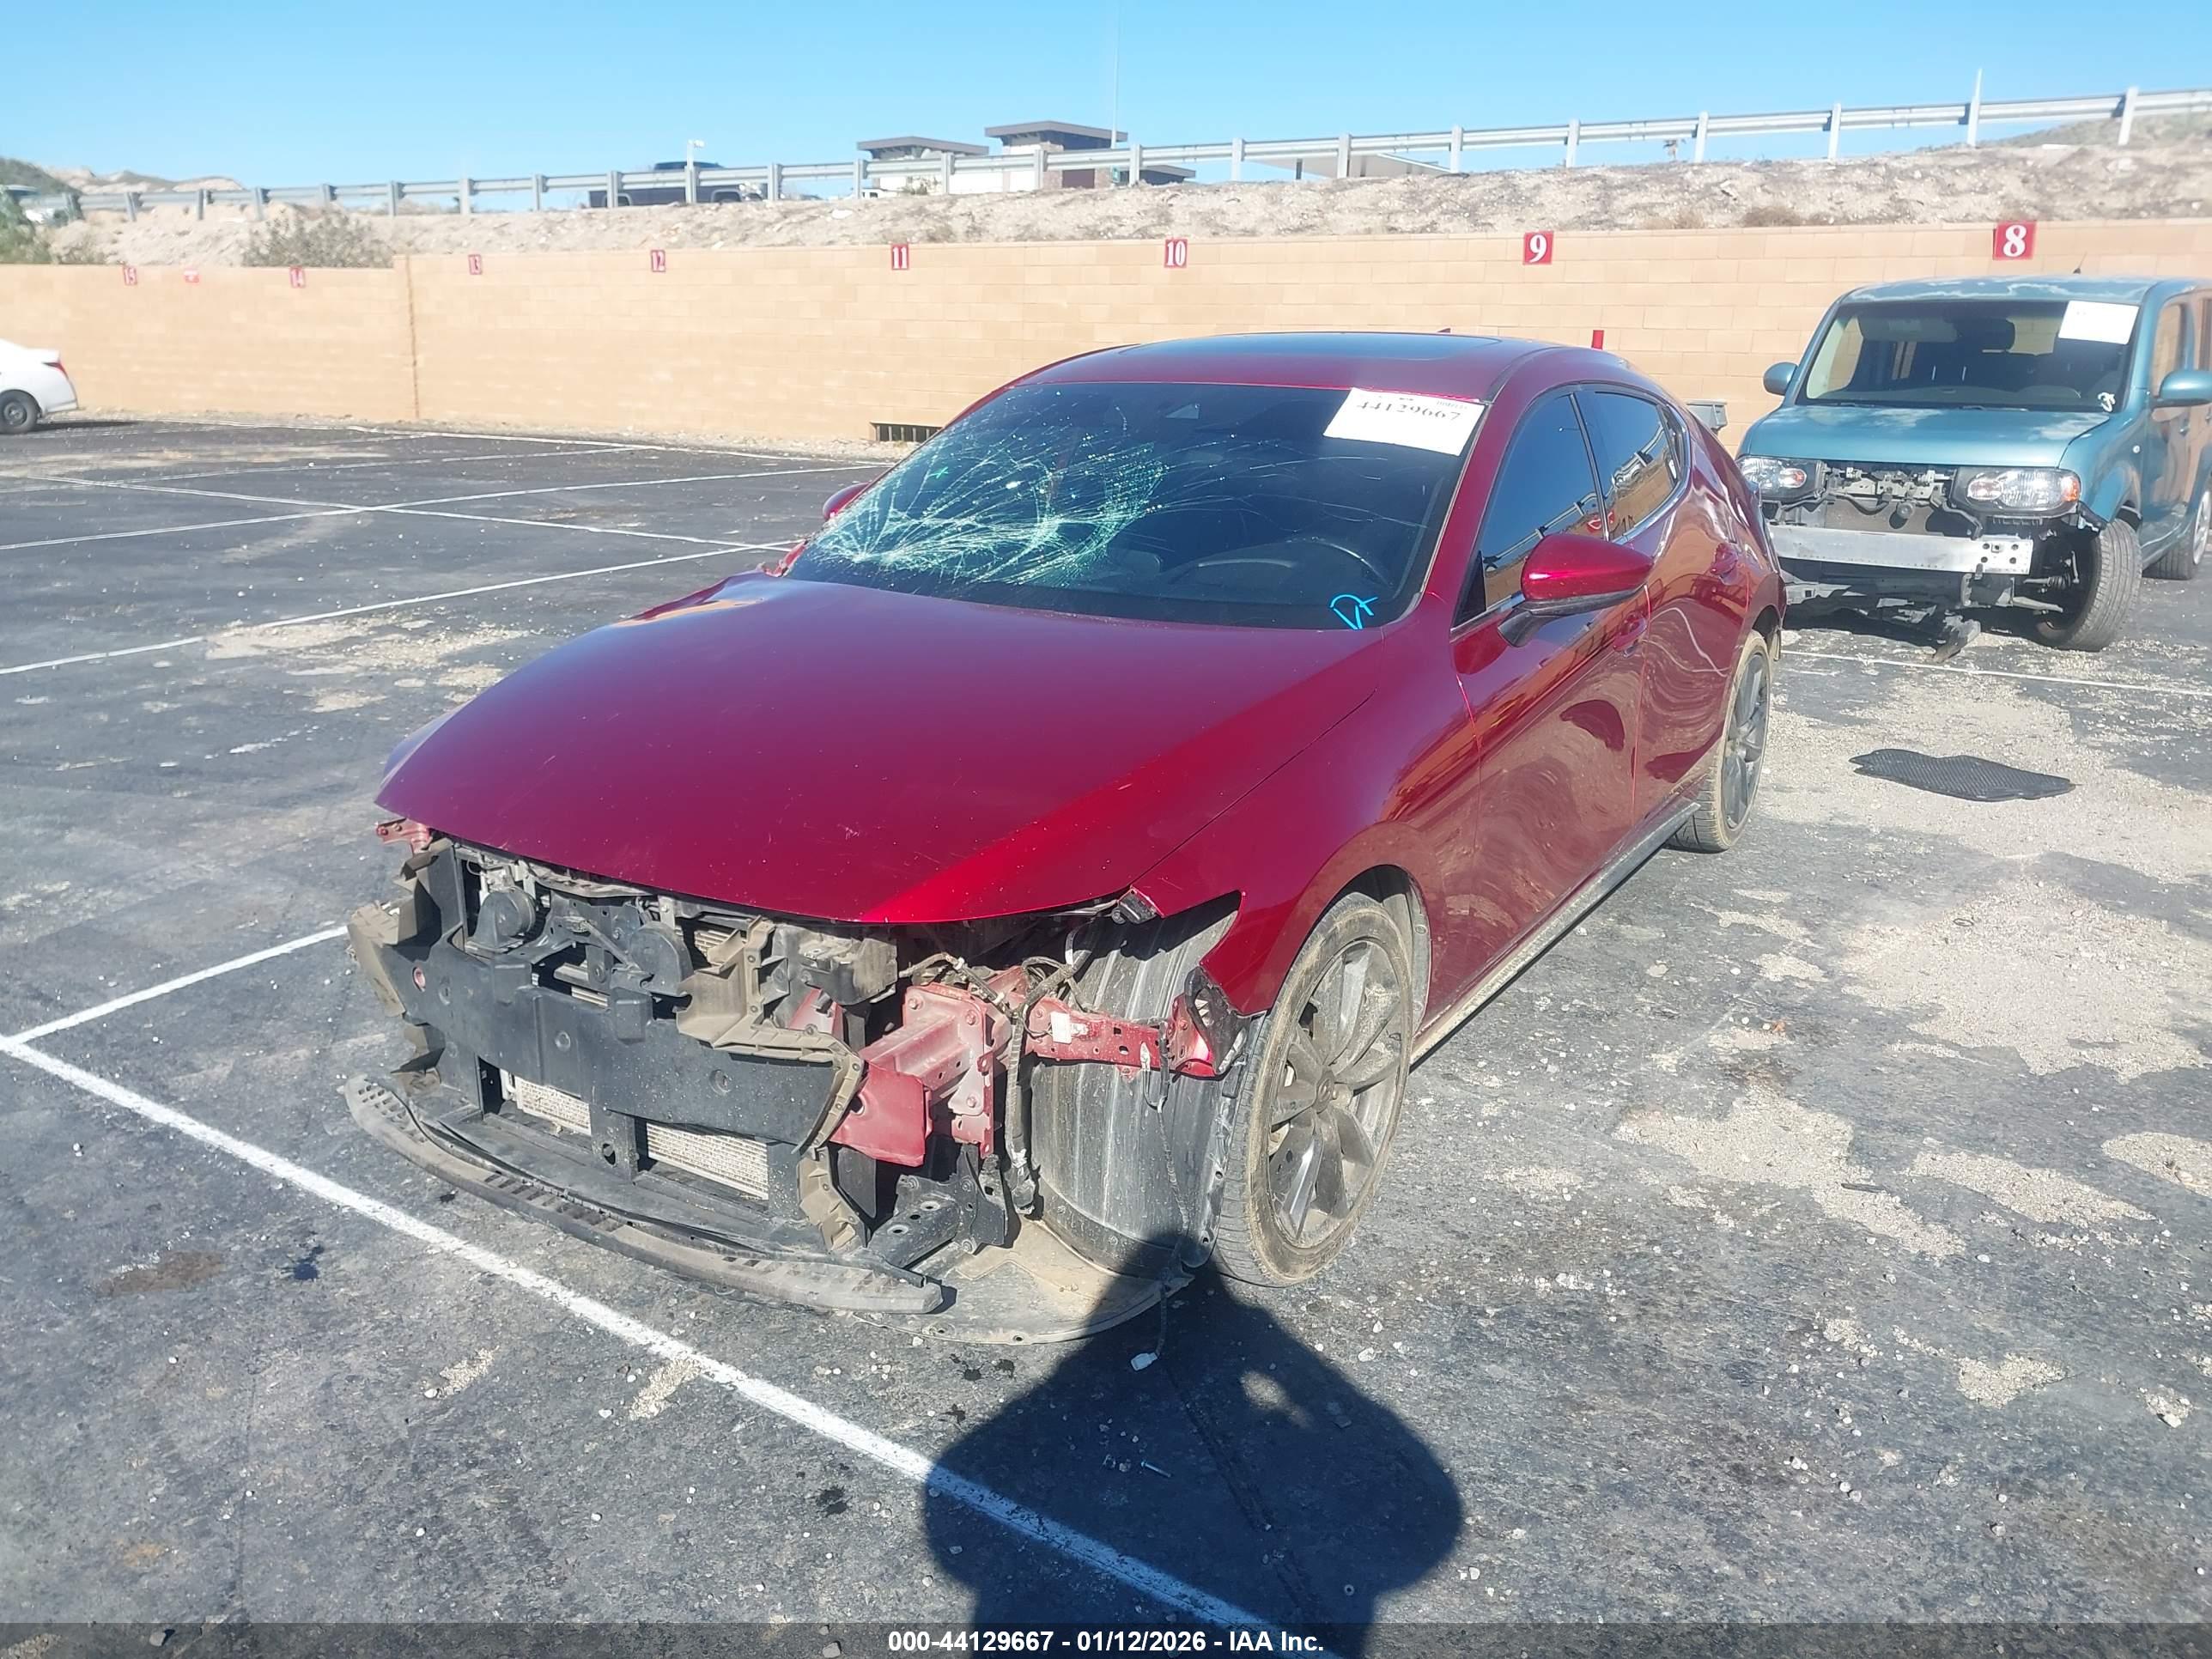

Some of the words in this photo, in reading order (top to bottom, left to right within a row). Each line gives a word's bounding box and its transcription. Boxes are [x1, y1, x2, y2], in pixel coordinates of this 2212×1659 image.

[1529, 234, 1547, 263] 9
[2002, 223, 2027, 258] 8
[470, 256, 481, 274] 13
[653, 251, 665, 271] 12
[893, 246, 908, 269] 11
[1166, 240, 1186, 266] 10
